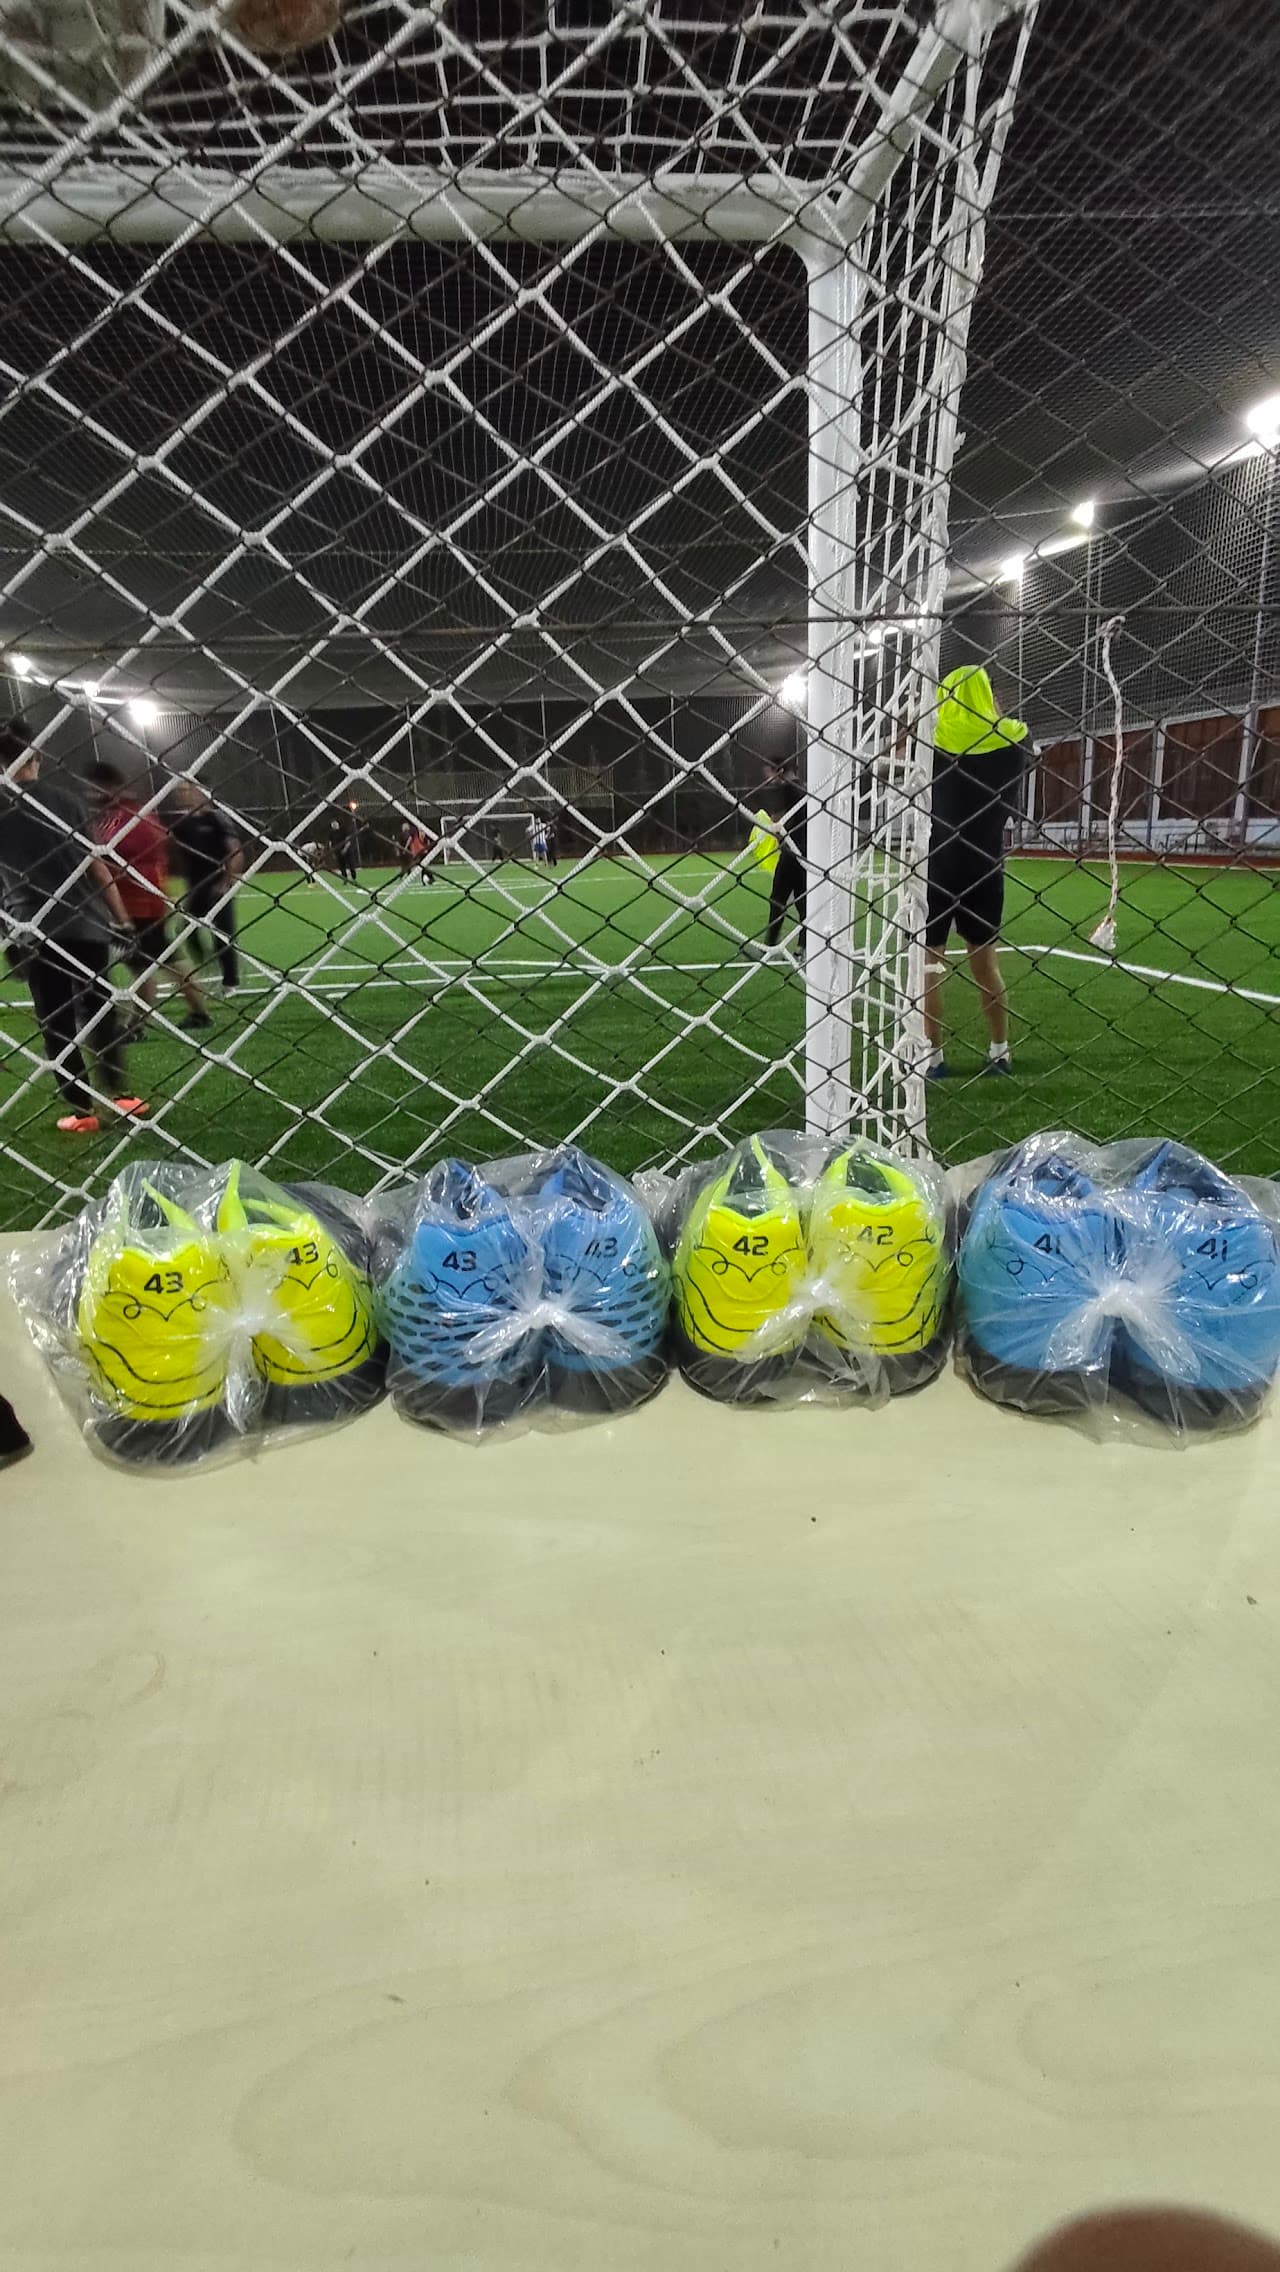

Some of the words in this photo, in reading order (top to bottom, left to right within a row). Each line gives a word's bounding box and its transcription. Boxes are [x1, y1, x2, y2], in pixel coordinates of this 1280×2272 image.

[732, 1235, 769, 1256] 42
[856, 1225, 893, 1246] 42
[1033, 1233, 1061, 1254] 41
[285, 1241, 319, 1265] 43
[441, 1250, 477, 1271] 43
[1197, 1238, 1227, 1262] 41
[143, 1271, 184, 1294] 43
